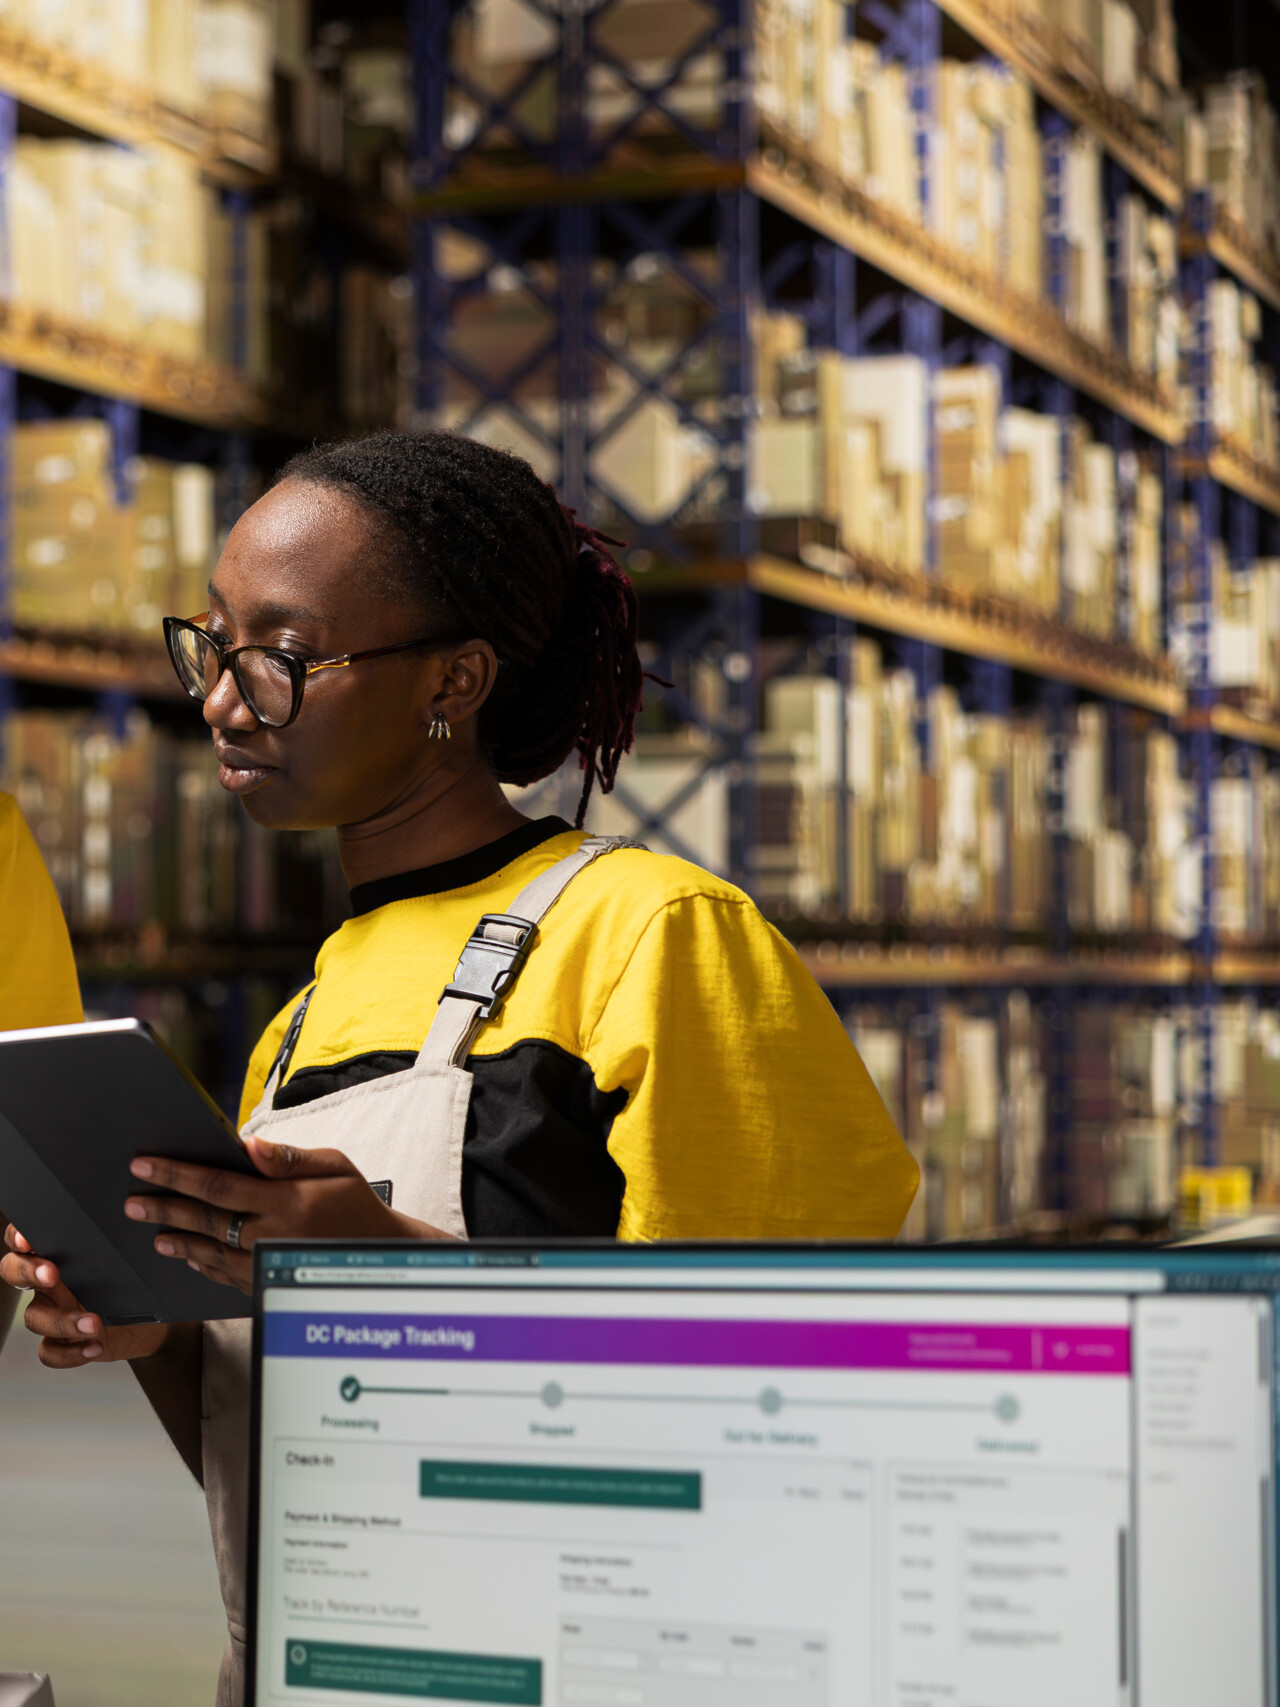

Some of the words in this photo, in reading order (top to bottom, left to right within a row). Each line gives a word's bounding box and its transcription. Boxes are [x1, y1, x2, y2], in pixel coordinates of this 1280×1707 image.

[306, 1325, 330, 1343] DC
[333, 1325, 401, 1349] Package
[404, 1326, 474, 1350] Tracking
[321, 1415, 379, 1431] Processing
